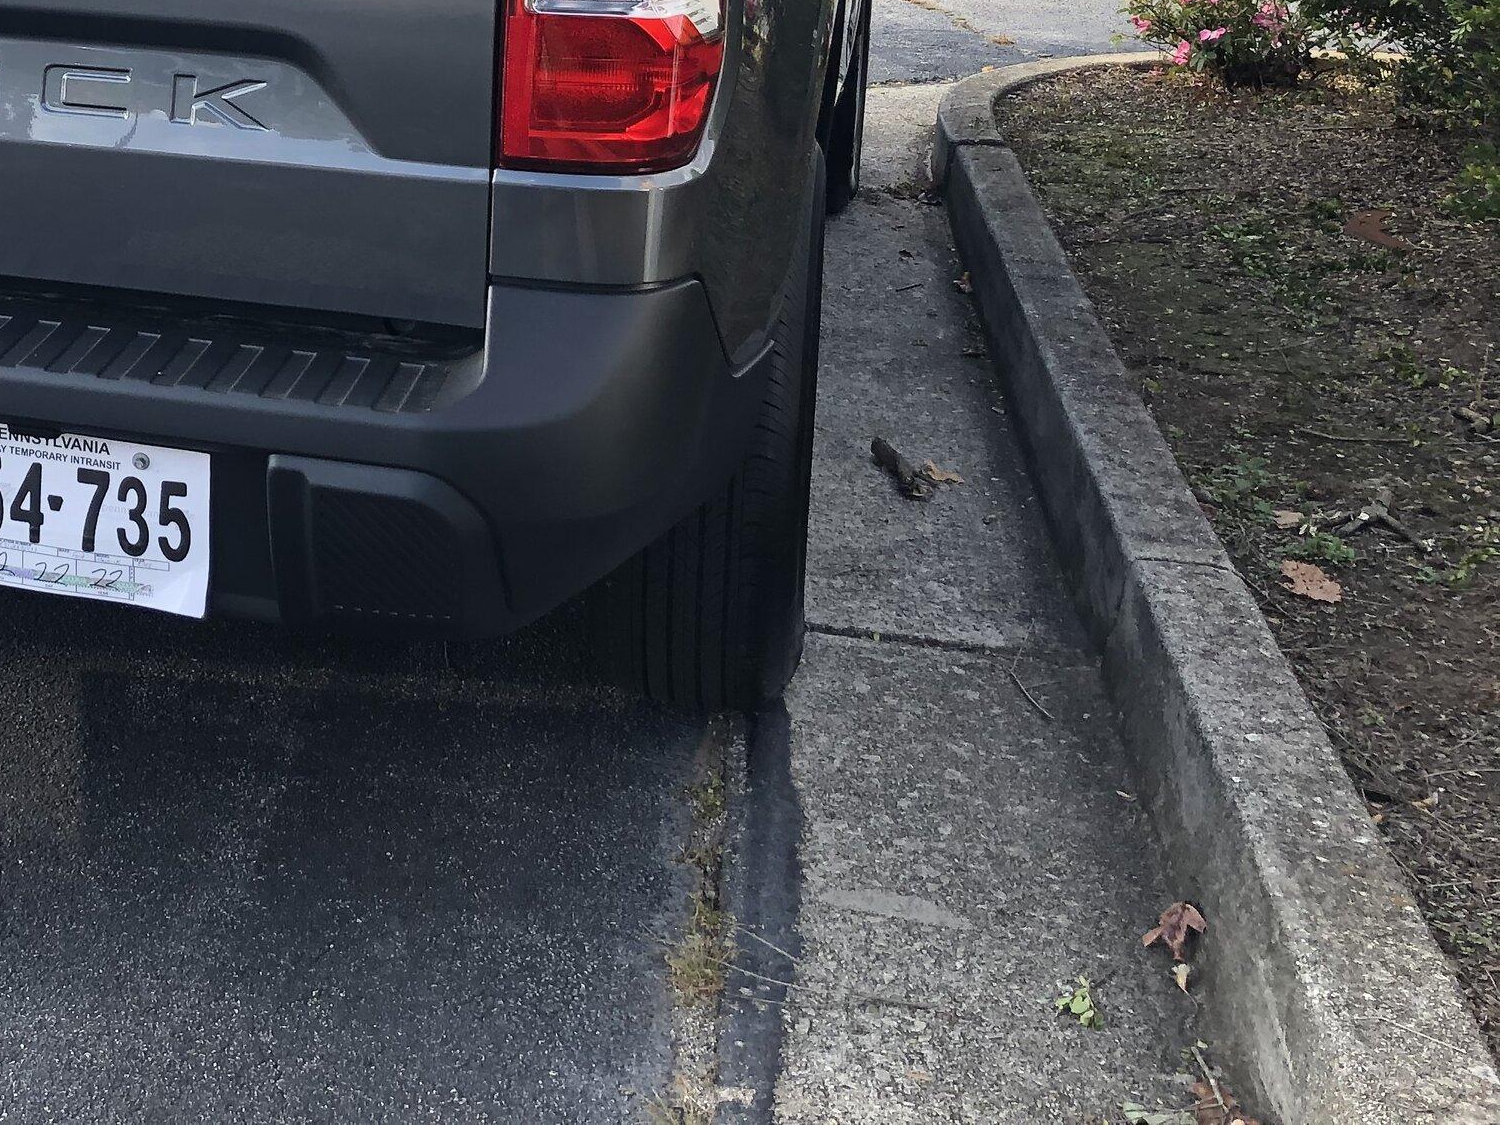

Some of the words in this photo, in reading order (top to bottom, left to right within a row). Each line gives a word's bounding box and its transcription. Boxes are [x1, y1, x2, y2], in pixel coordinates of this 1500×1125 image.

[9, 445, 69, 463] TEMPORARY
[70, 455, 122, 471] INTRANSIT
[33, 561, 68, 587] 22
[89, 568, 124, 591] 22
